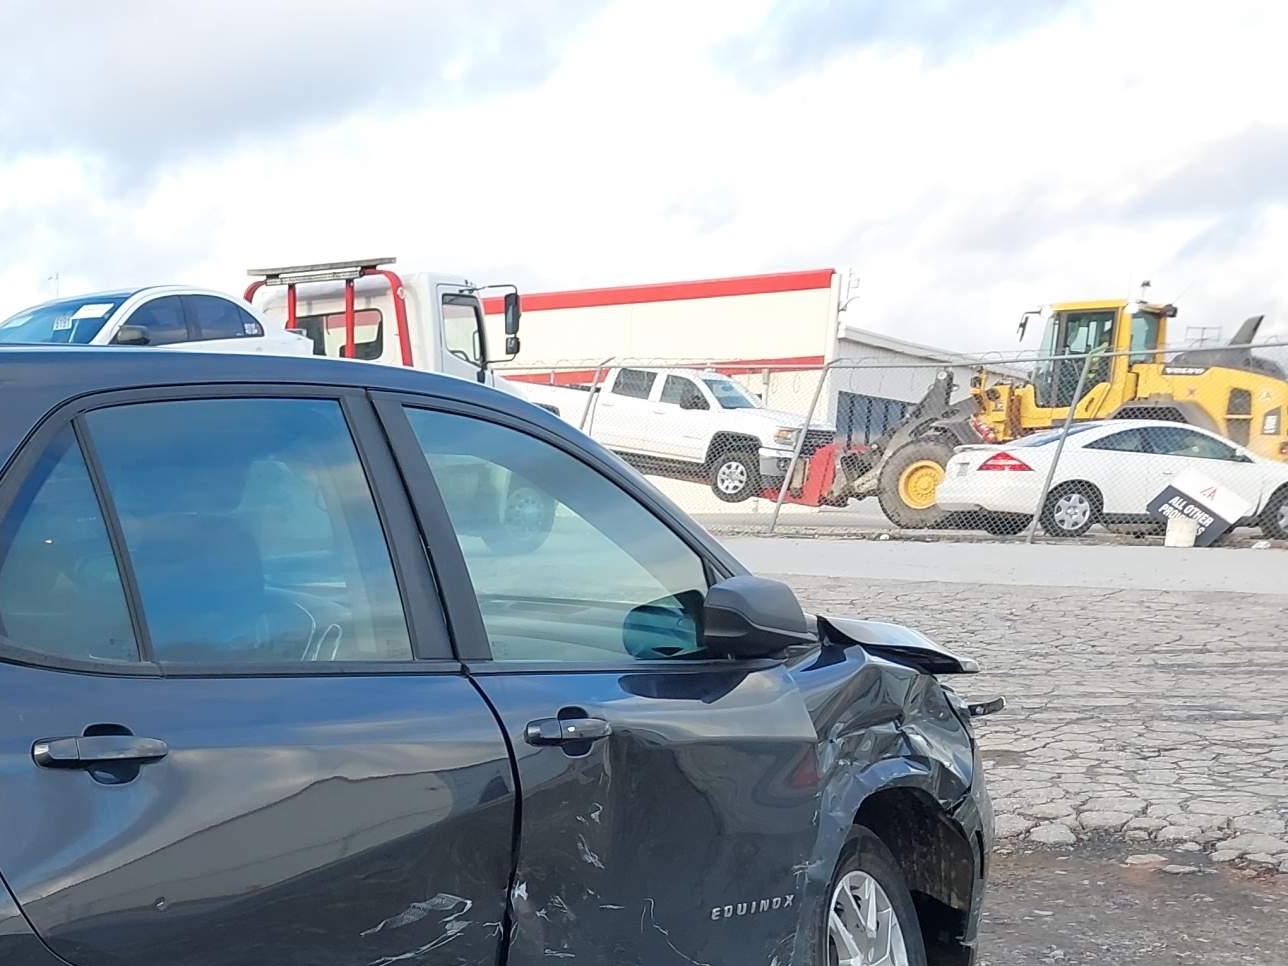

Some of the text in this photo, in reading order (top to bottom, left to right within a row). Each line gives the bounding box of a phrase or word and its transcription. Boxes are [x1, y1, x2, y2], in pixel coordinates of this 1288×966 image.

[1168, 496, 1214, 528] ALL OTHER
[711, 894, 795, 921] EQUINOX
